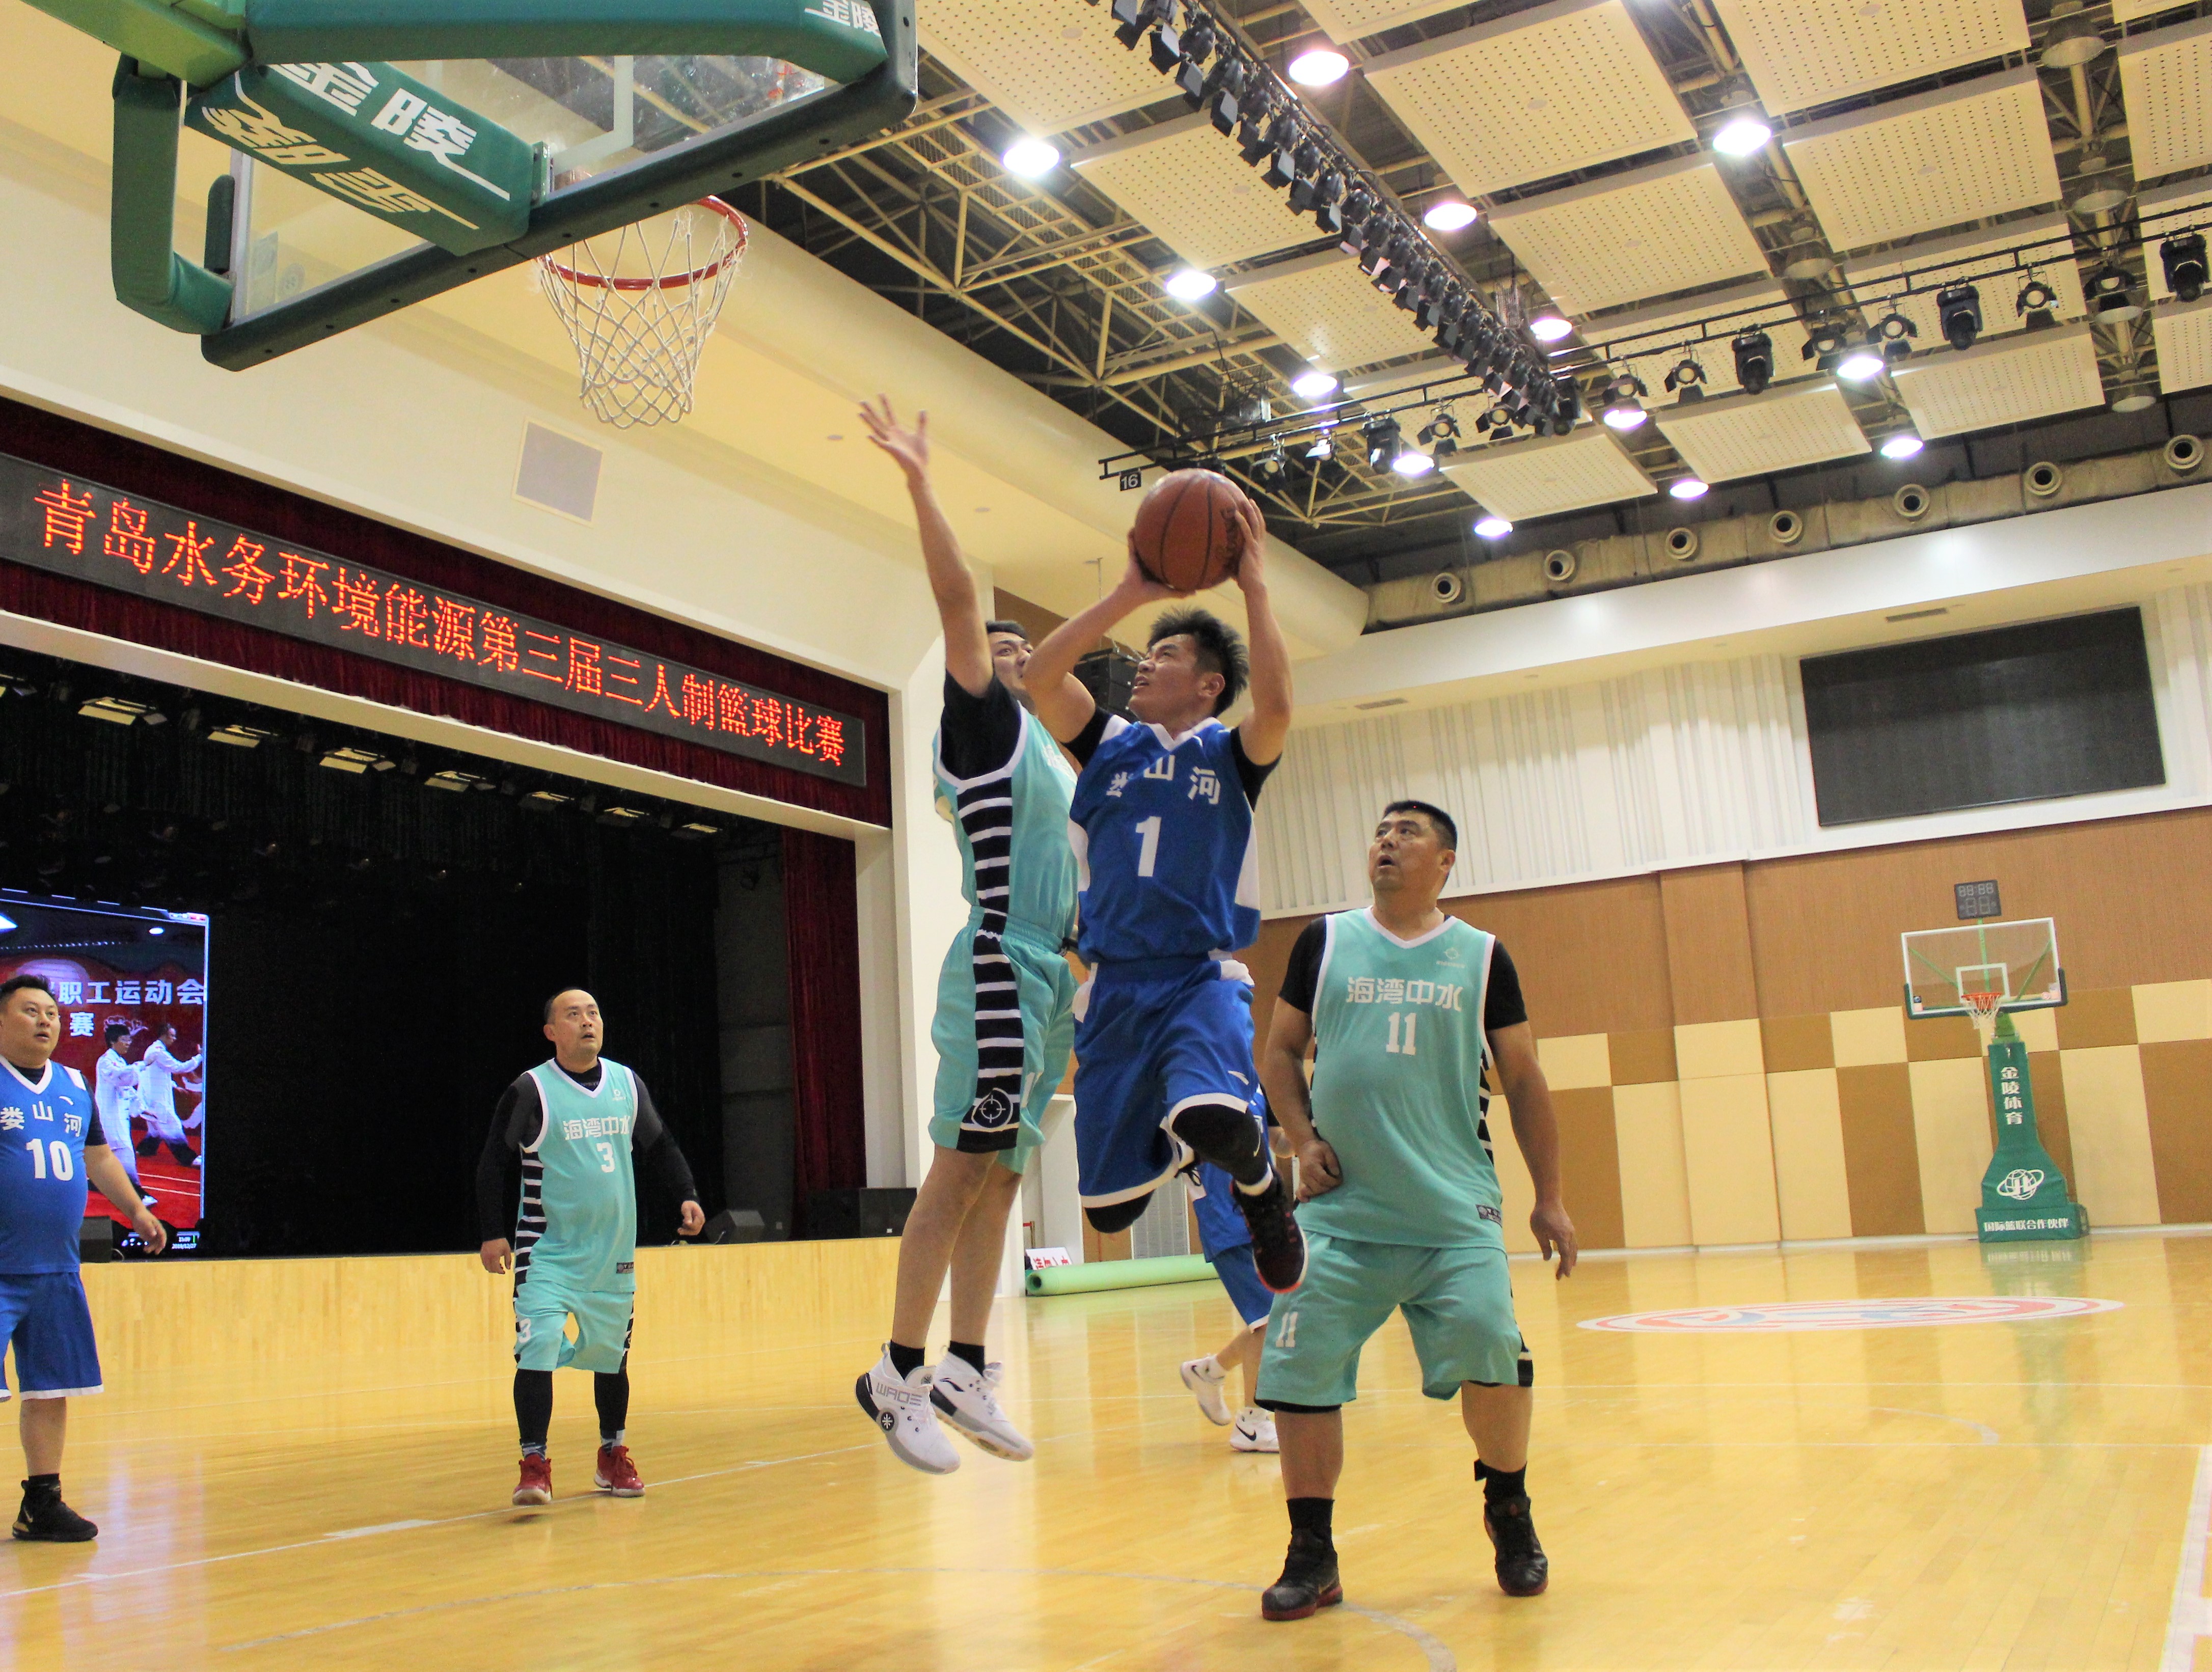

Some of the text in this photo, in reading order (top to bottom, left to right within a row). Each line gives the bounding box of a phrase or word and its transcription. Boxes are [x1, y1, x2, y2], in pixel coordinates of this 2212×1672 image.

[266, 62, 478, 156] 金陵
[1121, 474, 1138, 489] 16
[34, 478, 844, 767] 青岛水务环境能源第三届三人制篮球比赛
[1135, 815, 1162, 877] 1
[50, 978, 204, 1005] 职工运动会
[1346, 976, 1464, 1012] 海湾中水
[69, 1011, 95, 1037] 赛
[1385, 1011, 1417, 1056] 11
[2000, 1066, 2023, 1125] 金陵体育
[0, 1100, 83, 1137] 娄山河
[562, 1115, 631, 1140] 海湾中水
[26, 1138, 74, 1181] 10
[596, 1142, 615, 1173] 3
[1984, 1218, 2070, 1232] 国际篮联合作伙伴
[518, 1318, 531, 1344] 3
[1275, 1311, 1298, 1348] 11
[876, 1382, 922, 1407] WADE
